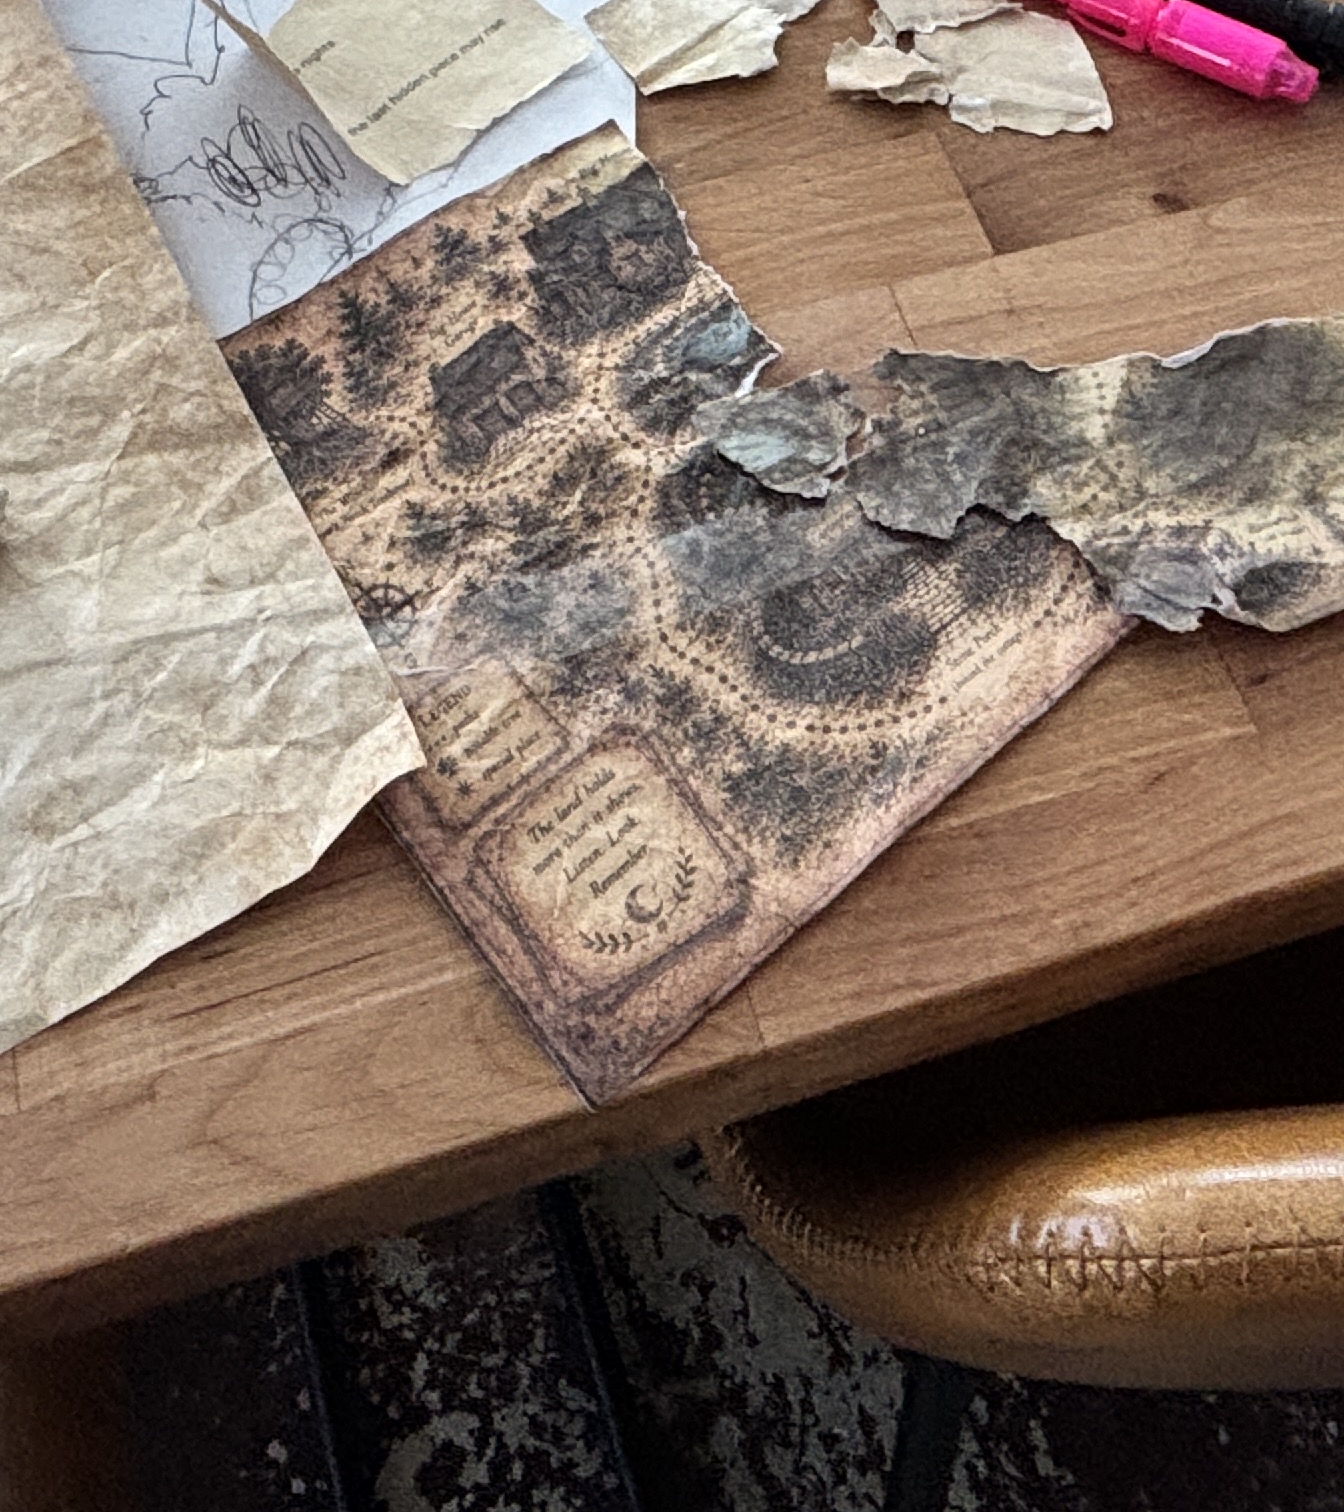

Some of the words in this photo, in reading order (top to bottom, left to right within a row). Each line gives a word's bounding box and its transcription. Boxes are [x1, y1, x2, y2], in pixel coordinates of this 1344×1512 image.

[527, 821, 555, 844] The
[554, 785, 584, 823] land
[583, 767, 616, 797] holds
[533, 848, 563, 876] more
[563, 821, 591, 848] than
